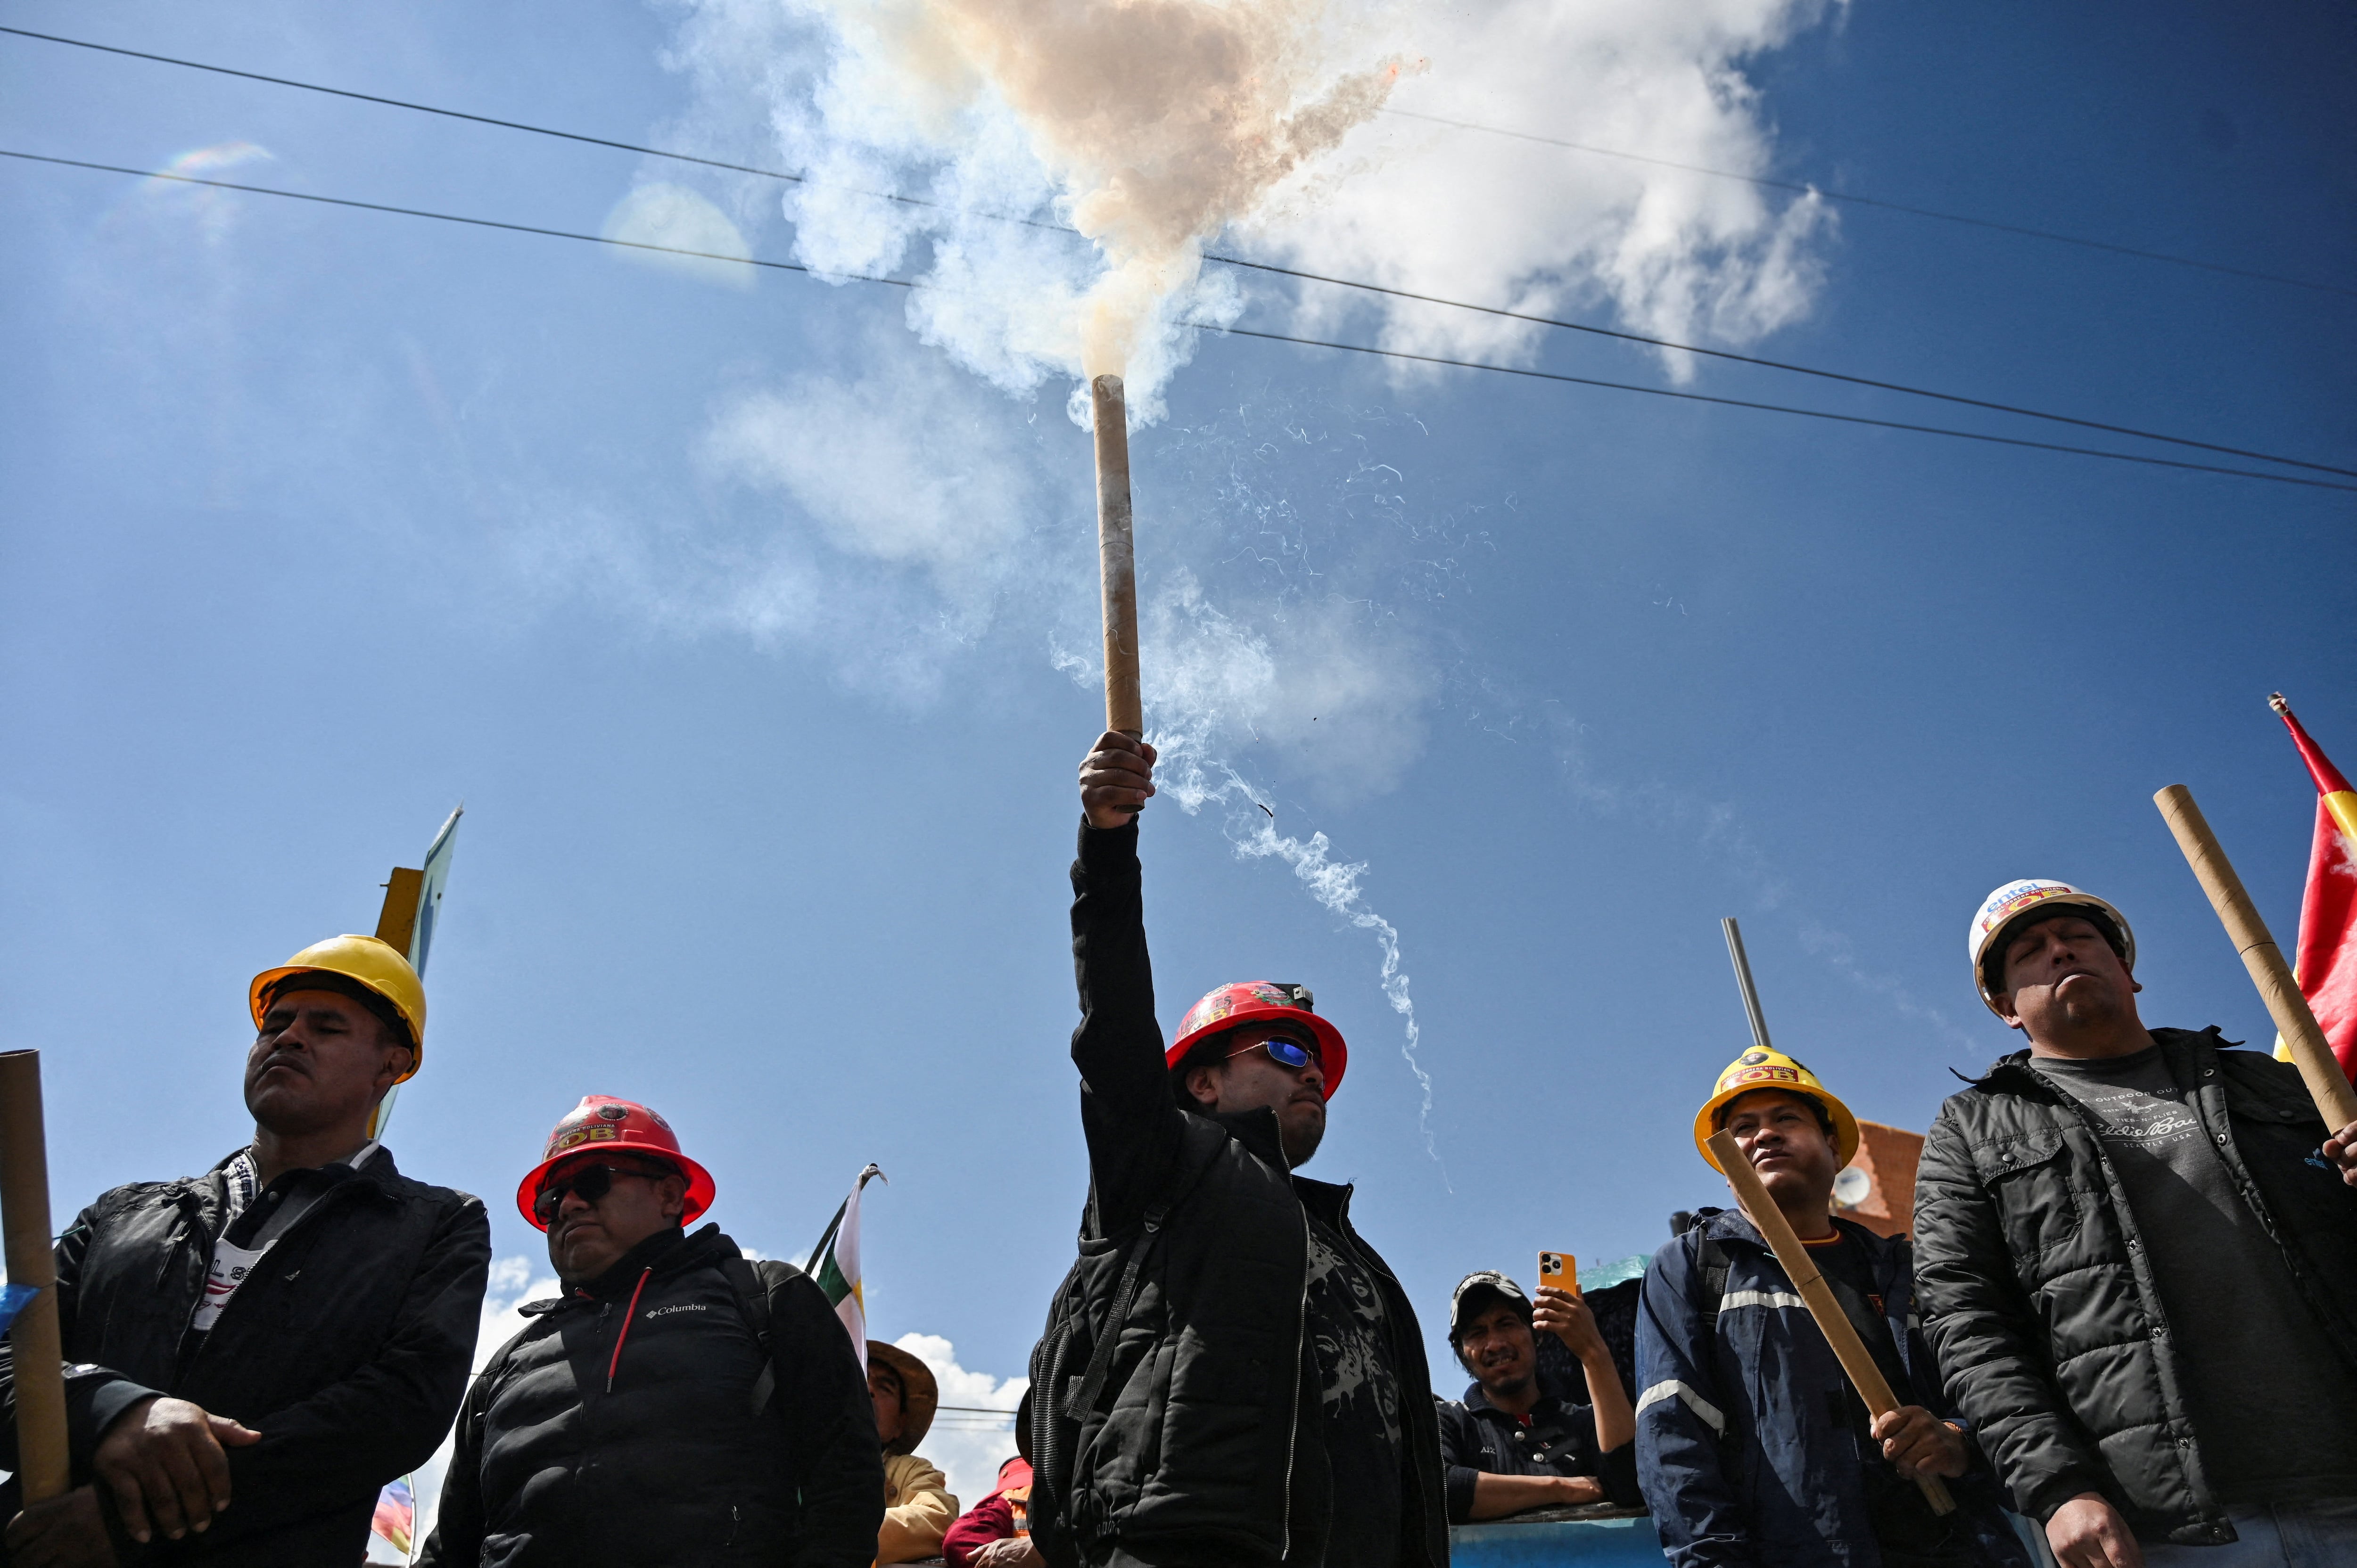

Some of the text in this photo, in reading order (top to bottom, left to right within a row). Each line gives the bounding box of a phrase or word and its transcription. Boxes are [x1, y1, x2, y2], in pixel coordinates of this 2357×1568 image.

[1987, 883, 2042, 913] entel
[1983, 905, 2005, 925] CENRAL
[2006, 894, 2029, 905] OBRERA
[1722, 1070, 1796, 1091] COB
[2095, 1092, 2151, 1102] OUTDOOR
[2115, 1110, 2177, 1122] TIES-N-FLIES
[2146, 1116, 2198, 1136] Bau
[560, 1128, 580, 1139] OBRERA
[2172, 1133, 2192, 1142] USA
[657, 1304, 706, 1315] Columbia
